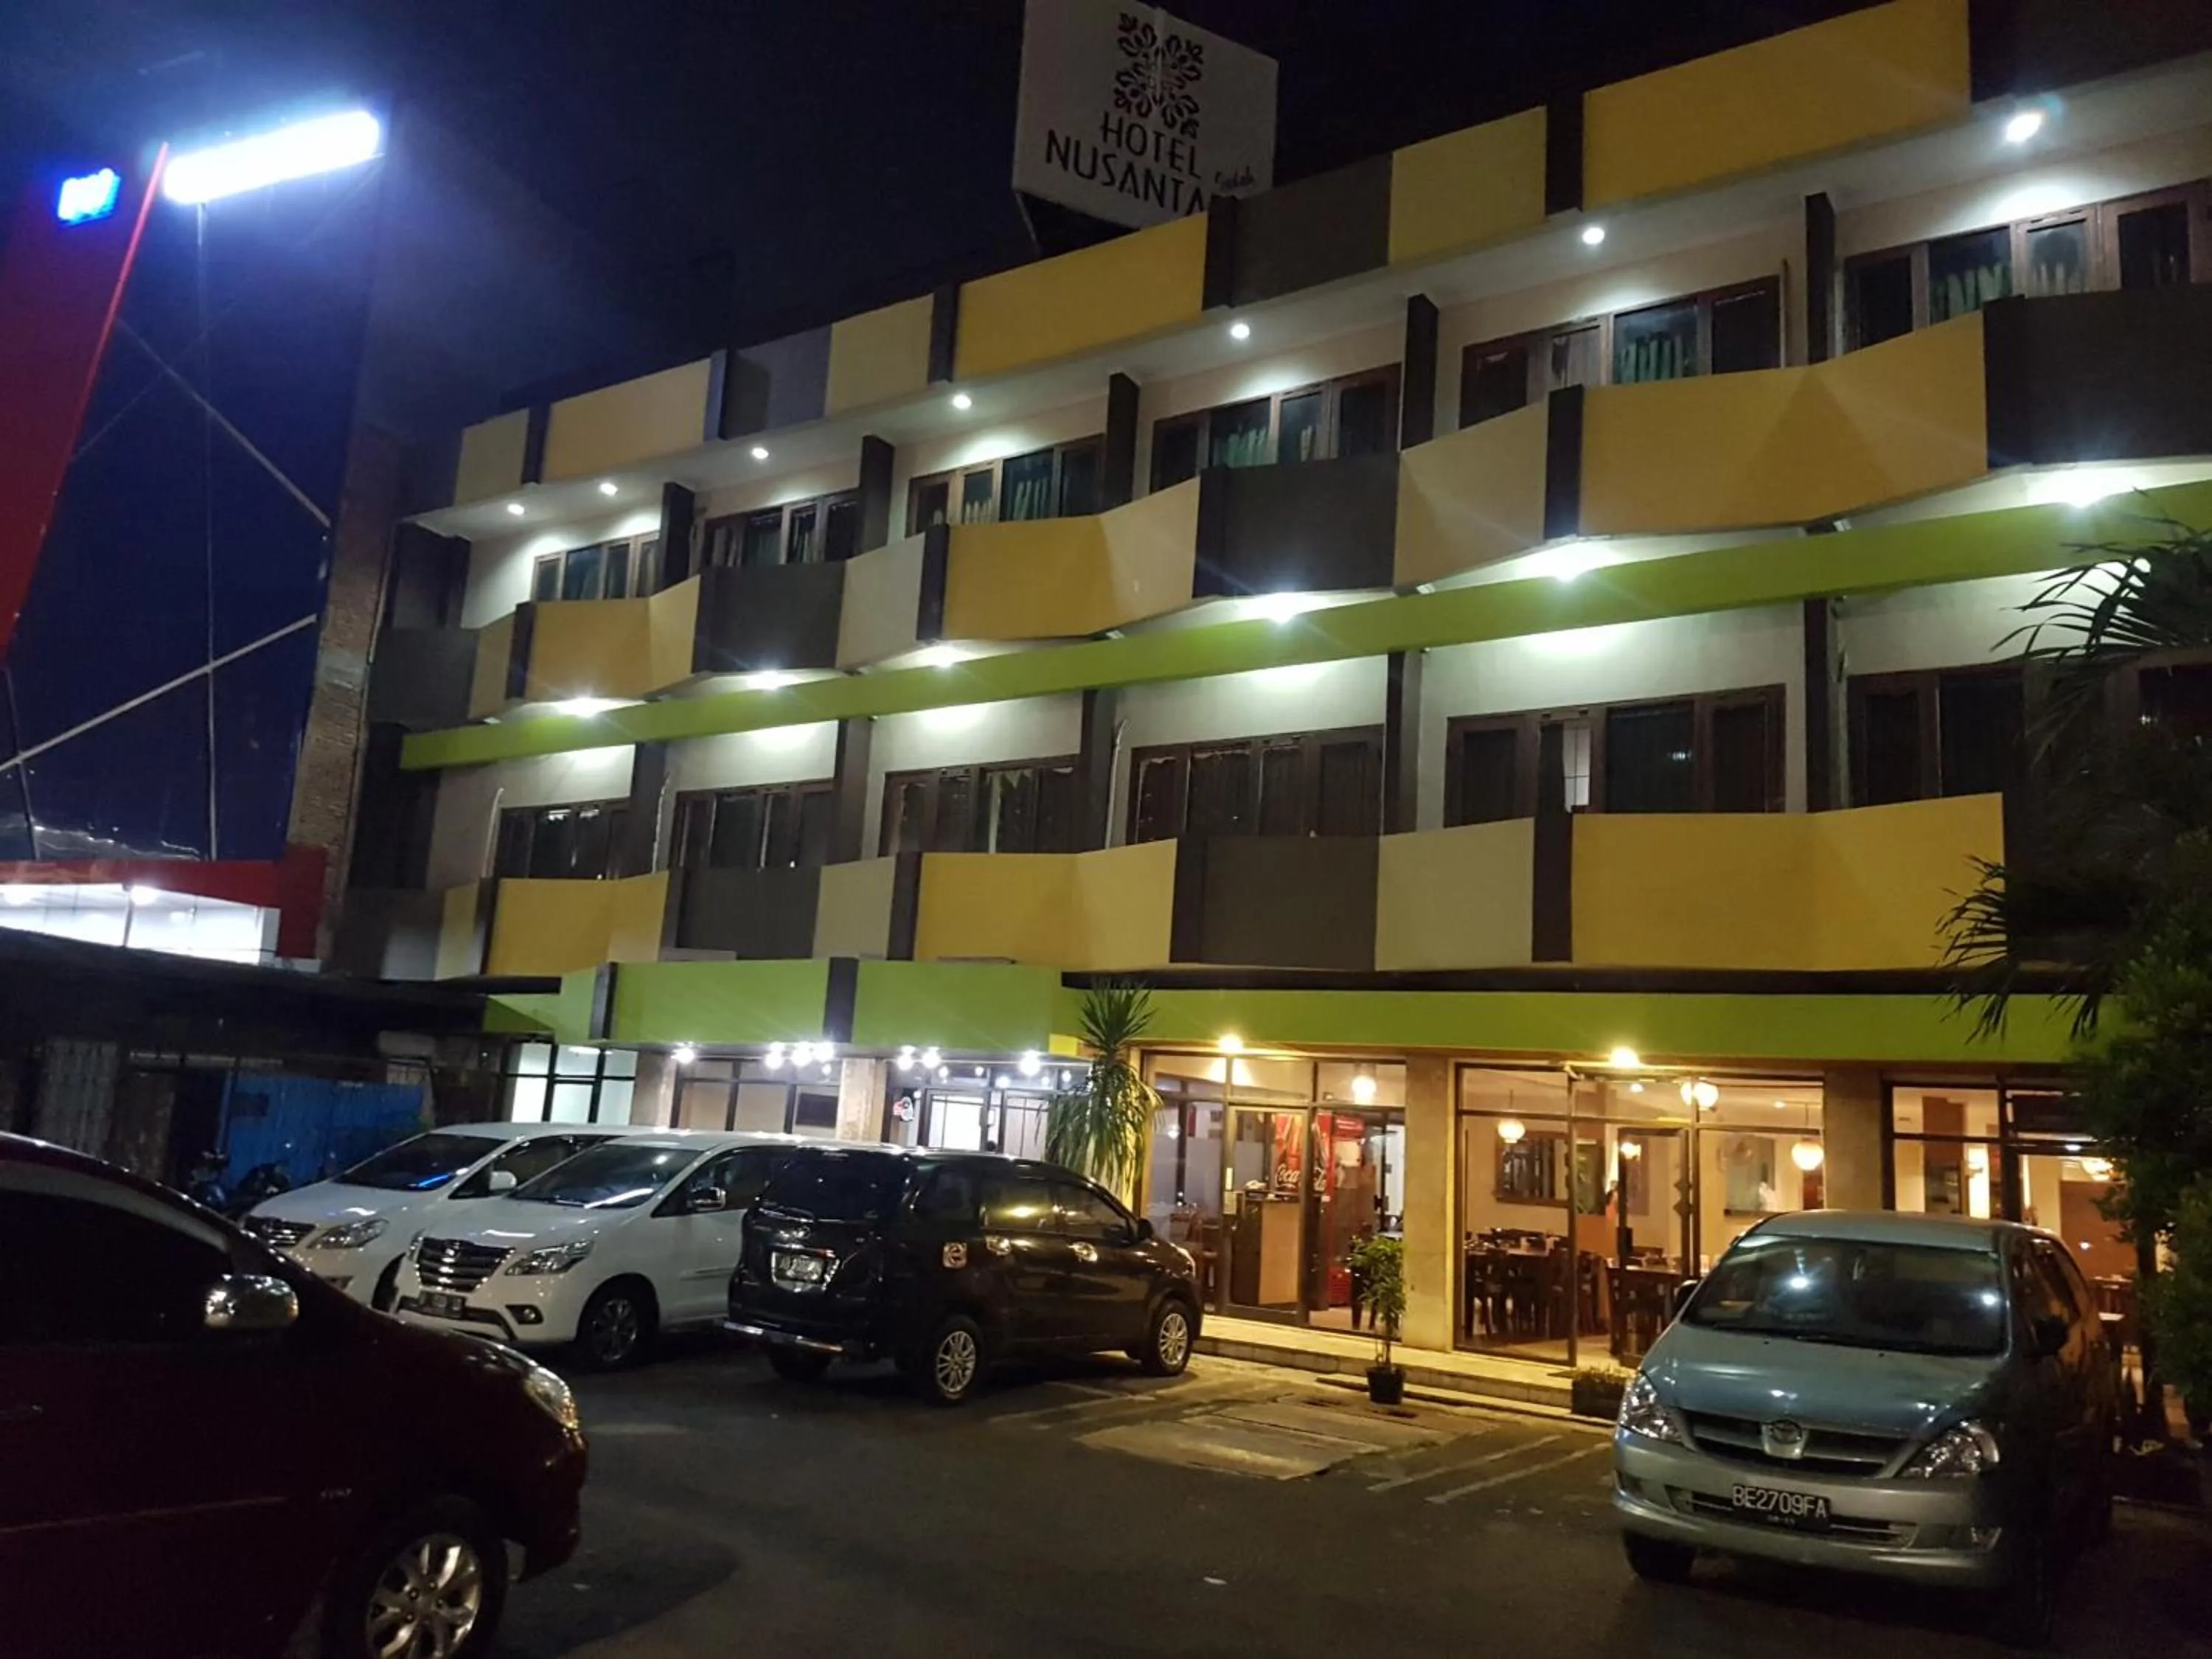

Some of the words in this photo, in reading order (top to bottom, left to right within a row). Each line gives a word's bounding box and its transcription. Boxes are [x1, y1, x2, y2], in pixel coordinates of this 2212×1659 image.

[1100, 111, 1202, 180] HOTEL
[1274, 1163, 1301, 1189] Coca
[1732, 1485, 1827, 1519] BE2709FA
